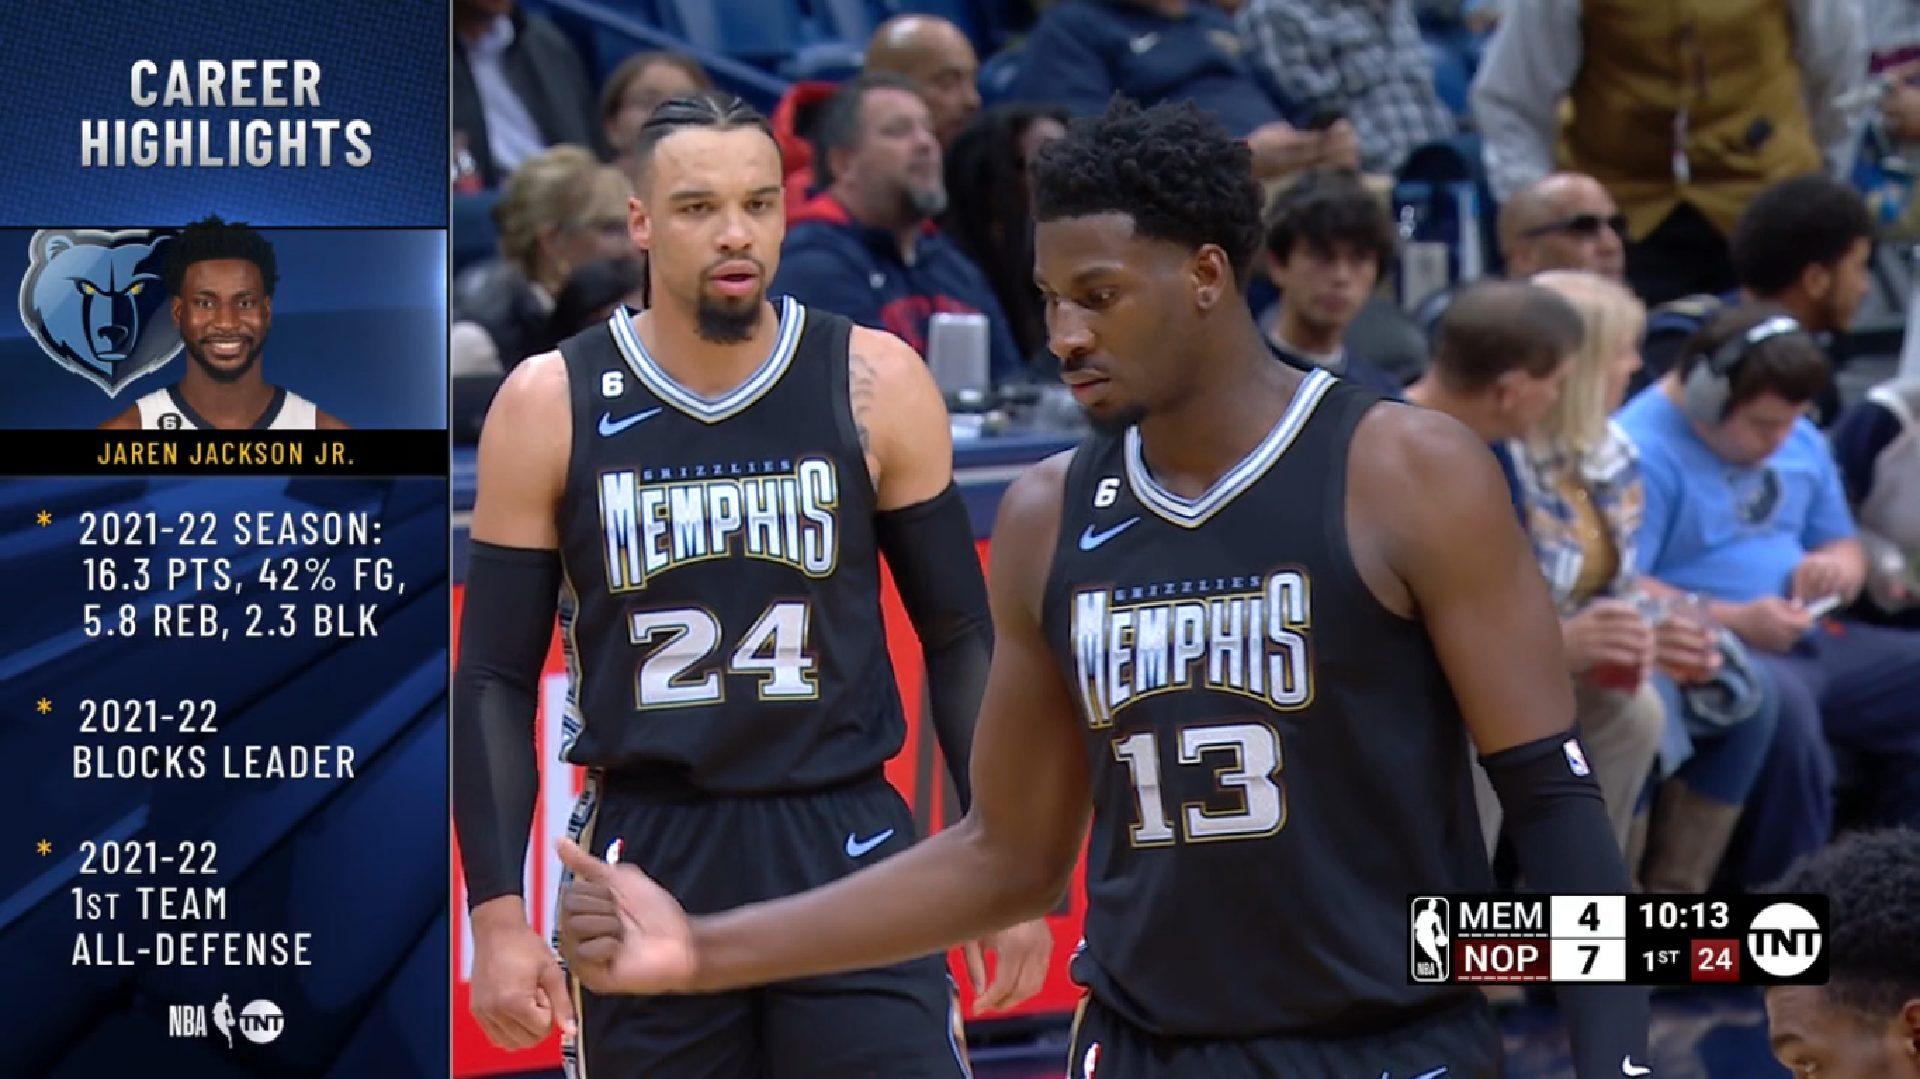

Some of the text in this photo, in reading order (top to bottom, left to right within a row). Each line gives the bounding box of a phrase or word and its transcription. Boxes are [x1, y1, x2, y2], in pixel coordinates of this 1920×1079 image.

[602, 371, 624, 397] 6
[599, 456, 840, 594] MEMPHIS
[1094, 478, 1120, 507] 6
[628, 600, 820, 710] 24
[1072, 568, 1316, 728] MEMPHIS
[1112, 723, 1288, 847] 13
